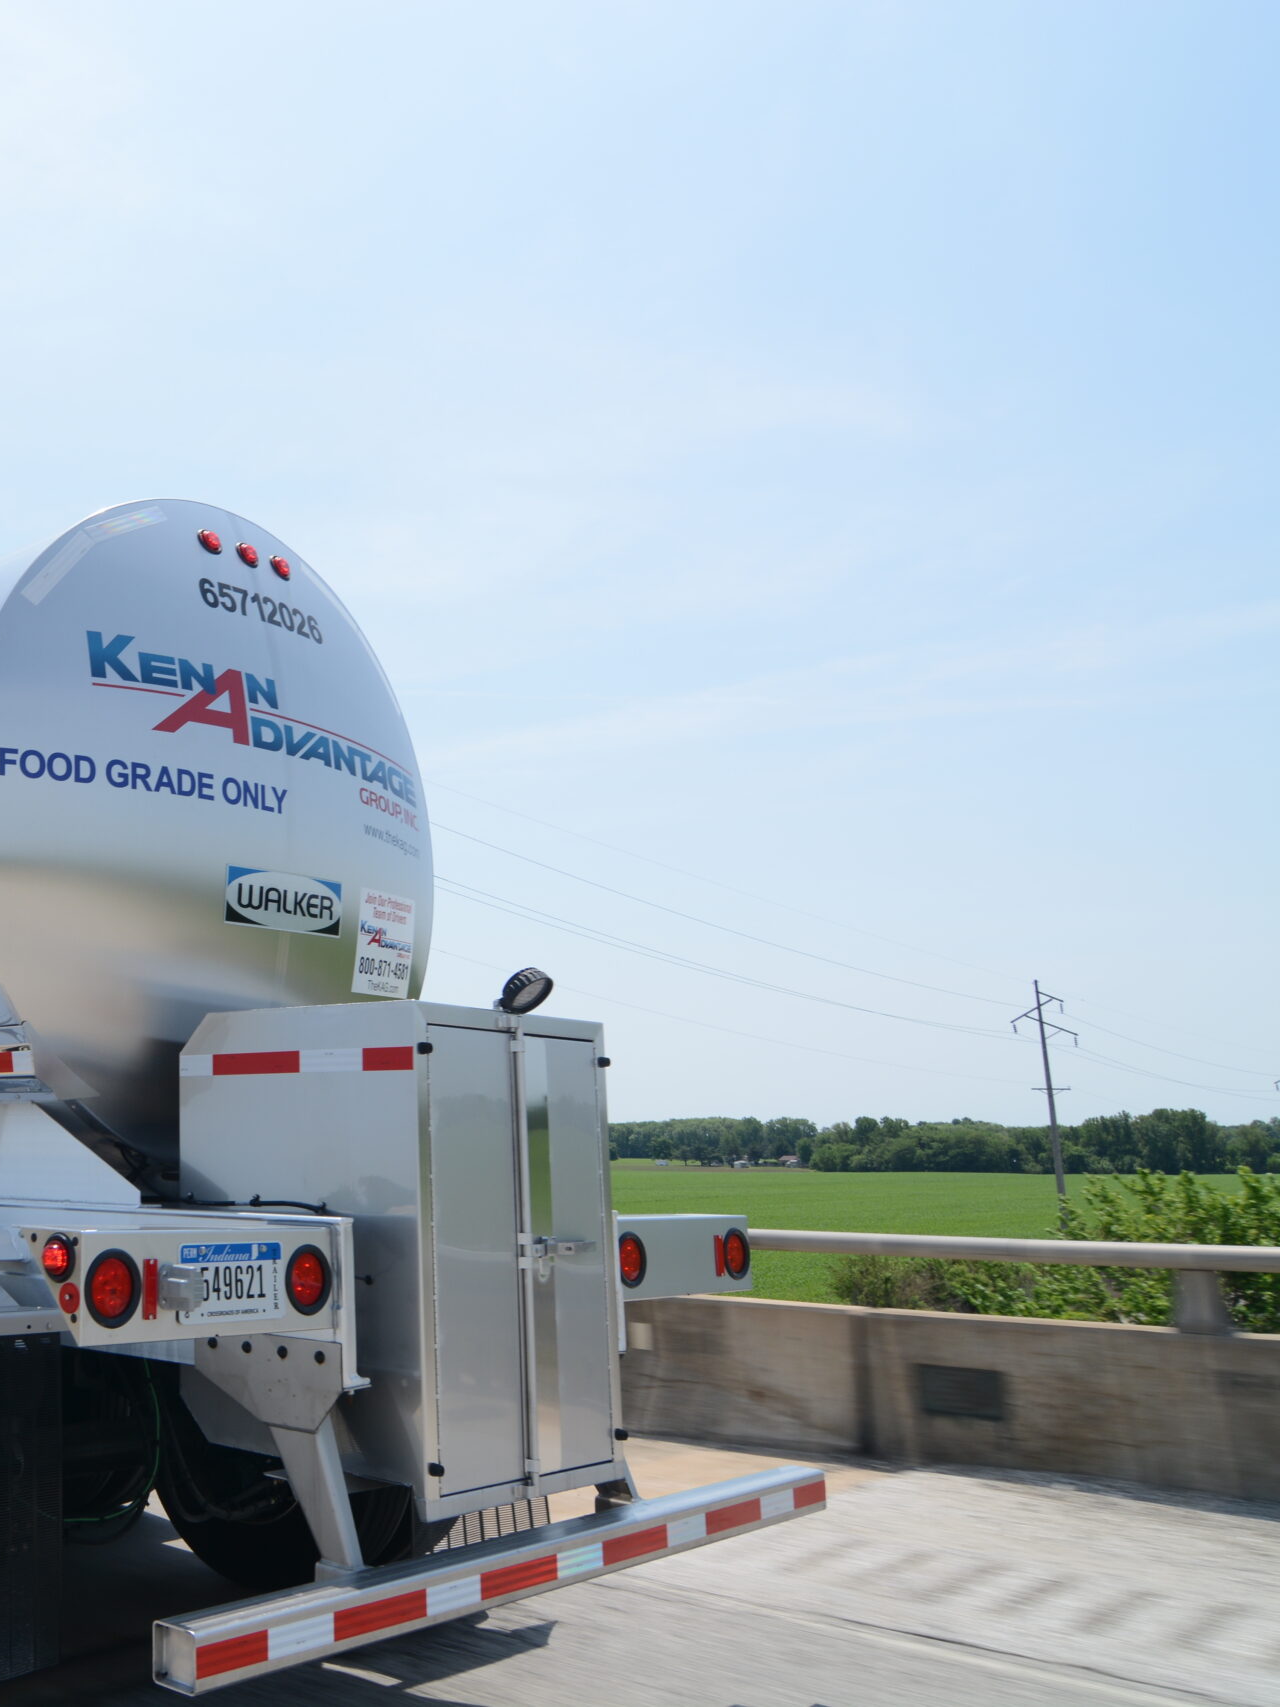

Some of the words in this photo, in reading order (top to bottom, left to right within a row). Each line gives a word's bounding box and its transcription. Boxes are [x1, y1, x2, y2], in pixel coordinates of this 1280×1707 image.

[198, 577, 323, 644] 65712026
[86, 630, 279, 711] KENAN
[151, 668, 417, 809] ADVANTAGE
[105, 759, 215, 801] GRADE
[222, 777, 288, 814] ONLY
[237, 883, 334, 921] WALKER
[199, 1244, 250, 1262] Indiana
